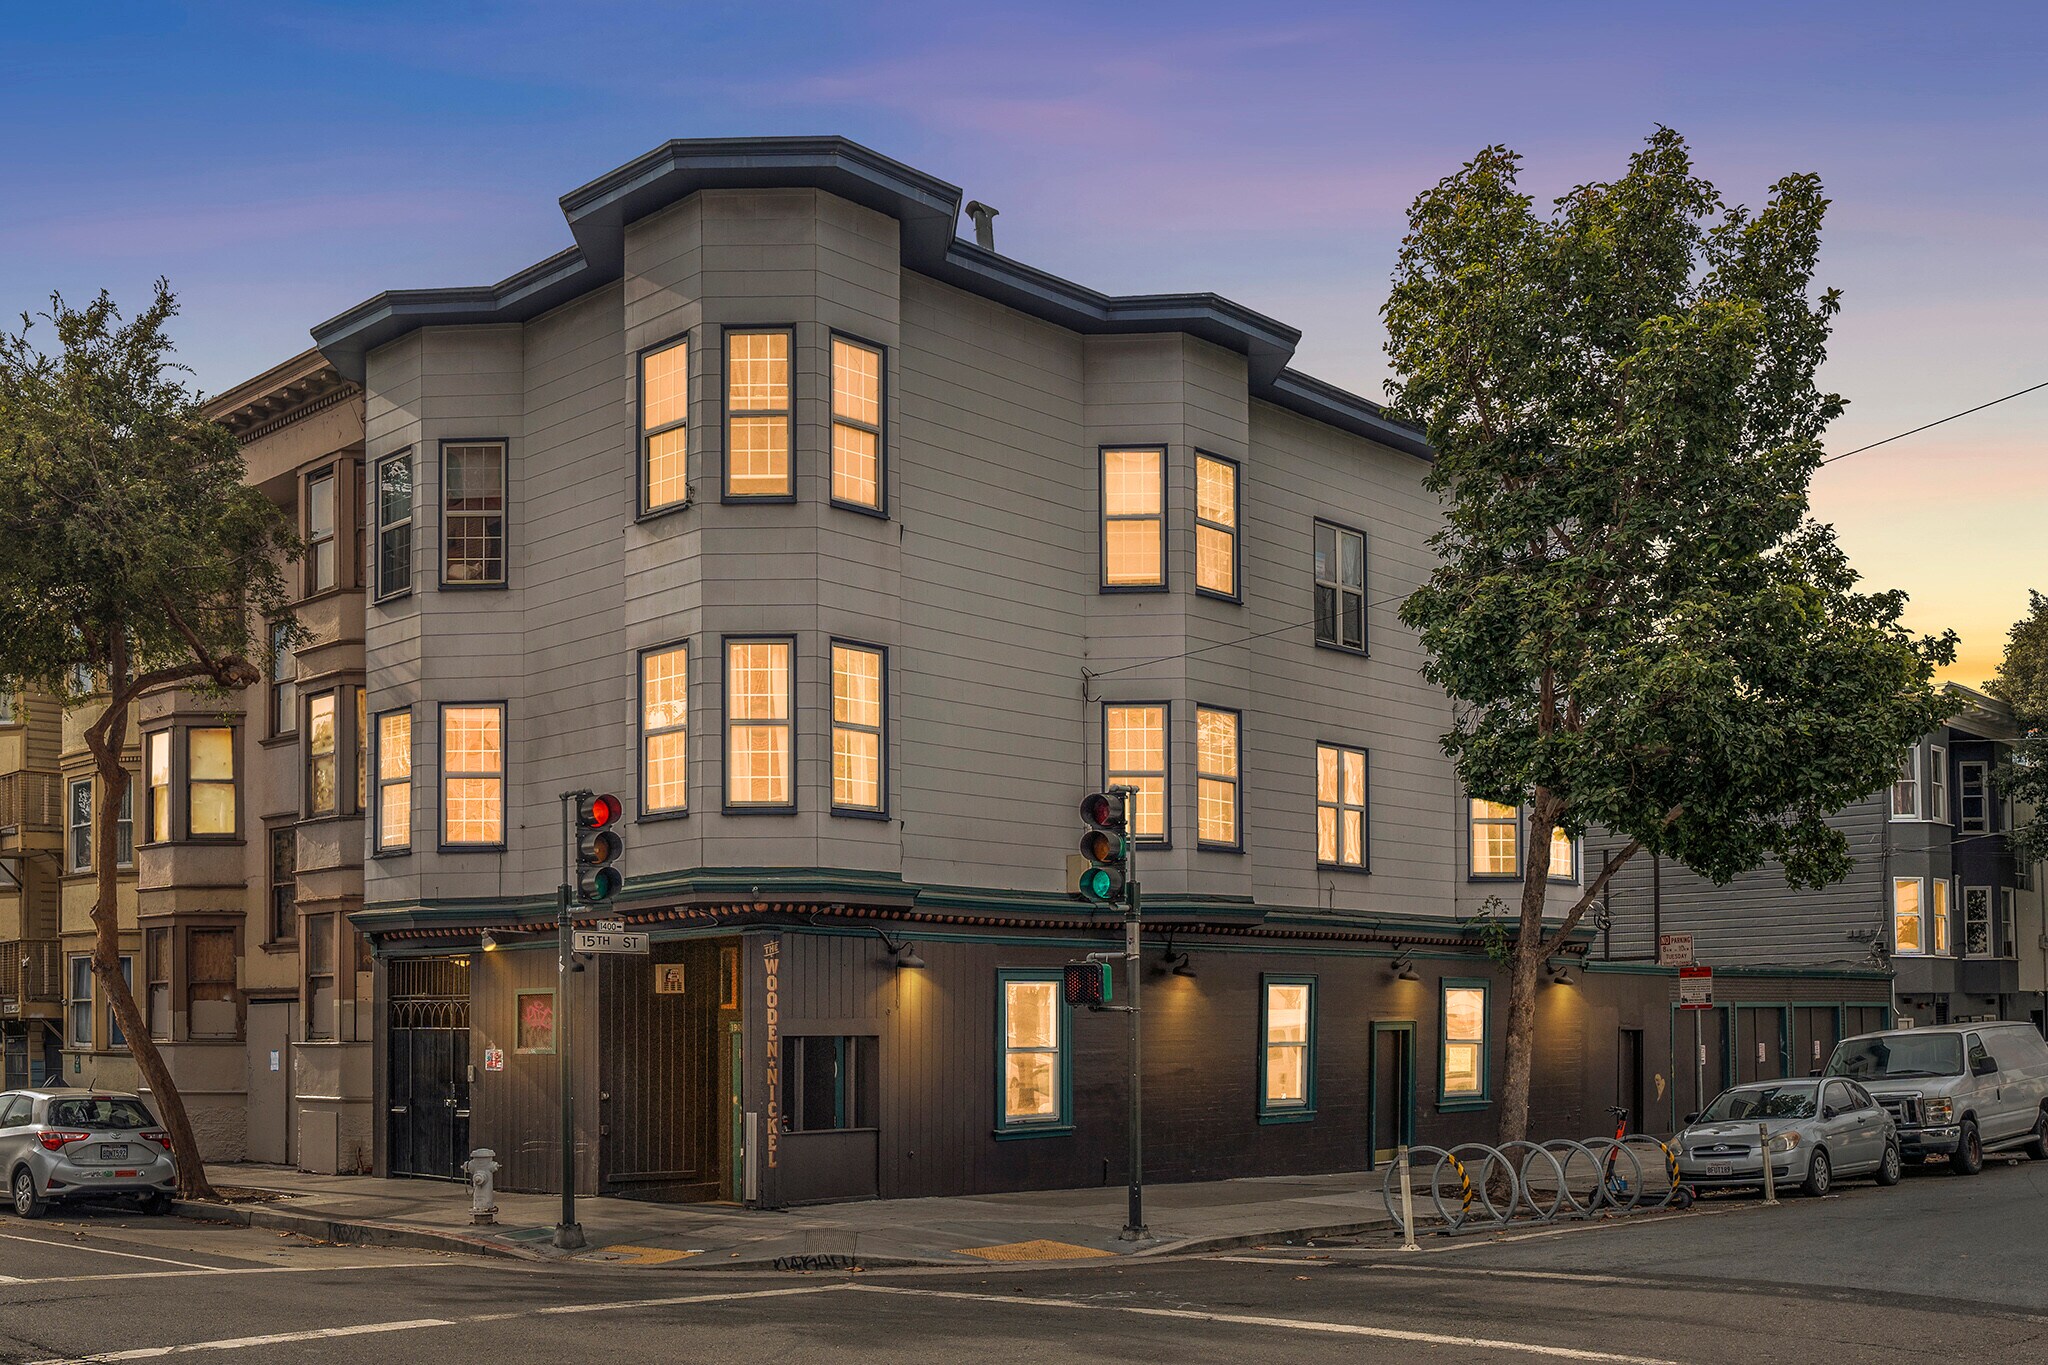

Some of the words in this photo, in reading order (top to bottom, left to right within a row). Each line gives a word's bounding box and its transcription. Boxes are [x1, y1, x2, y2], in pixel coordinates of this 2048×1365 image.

[582, 936, 610, 947] 15TH
[623, 937, 638, 948] ST
[764, 944, 779, 954] THE
[764, 959, 779, 1058] WOODEN
[767, 1068, 778, 1168] NICKEL
